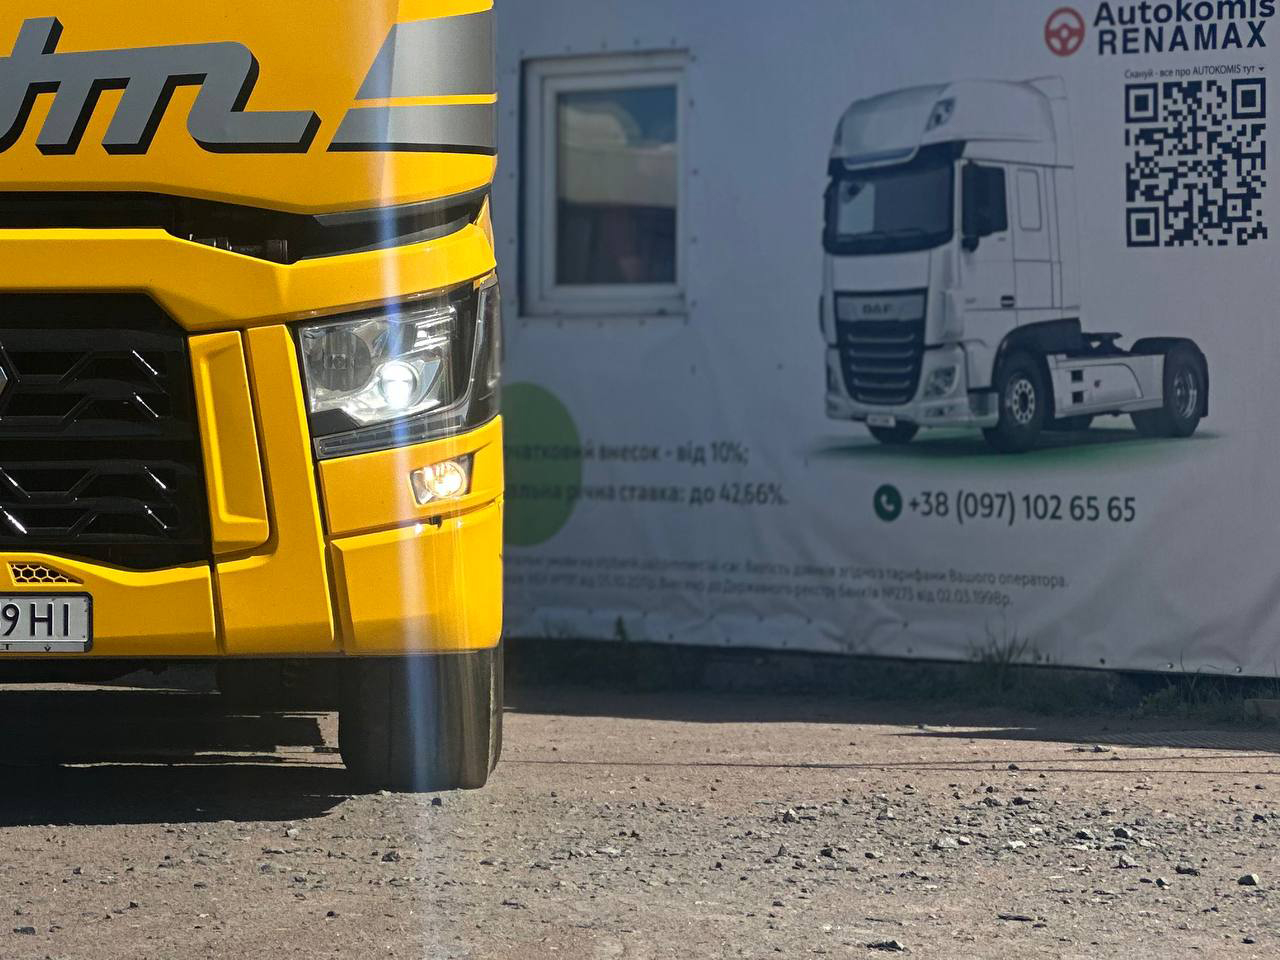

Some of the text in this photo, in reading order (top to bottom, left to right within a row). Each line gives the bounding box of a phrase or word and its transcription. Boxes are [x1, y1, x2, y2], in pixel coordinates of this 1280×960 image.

[1098, 20, 1267, 56] RENAMAX
[1123, 67, 1154, 80] Скануй
[1160, 69, 1174, 78] все
[1175, 68, 1191, 79] про
[1192, 63, 1241, 76] AUTOKOMIS
[1243, 64, 1256, 76] тут
[676, 440, 707, 467] від
[689, 486, 714, 507] до
[908, 489, 1136, 527] +38 (097) 102 65 65
[29, 601, 71, 637] HI
